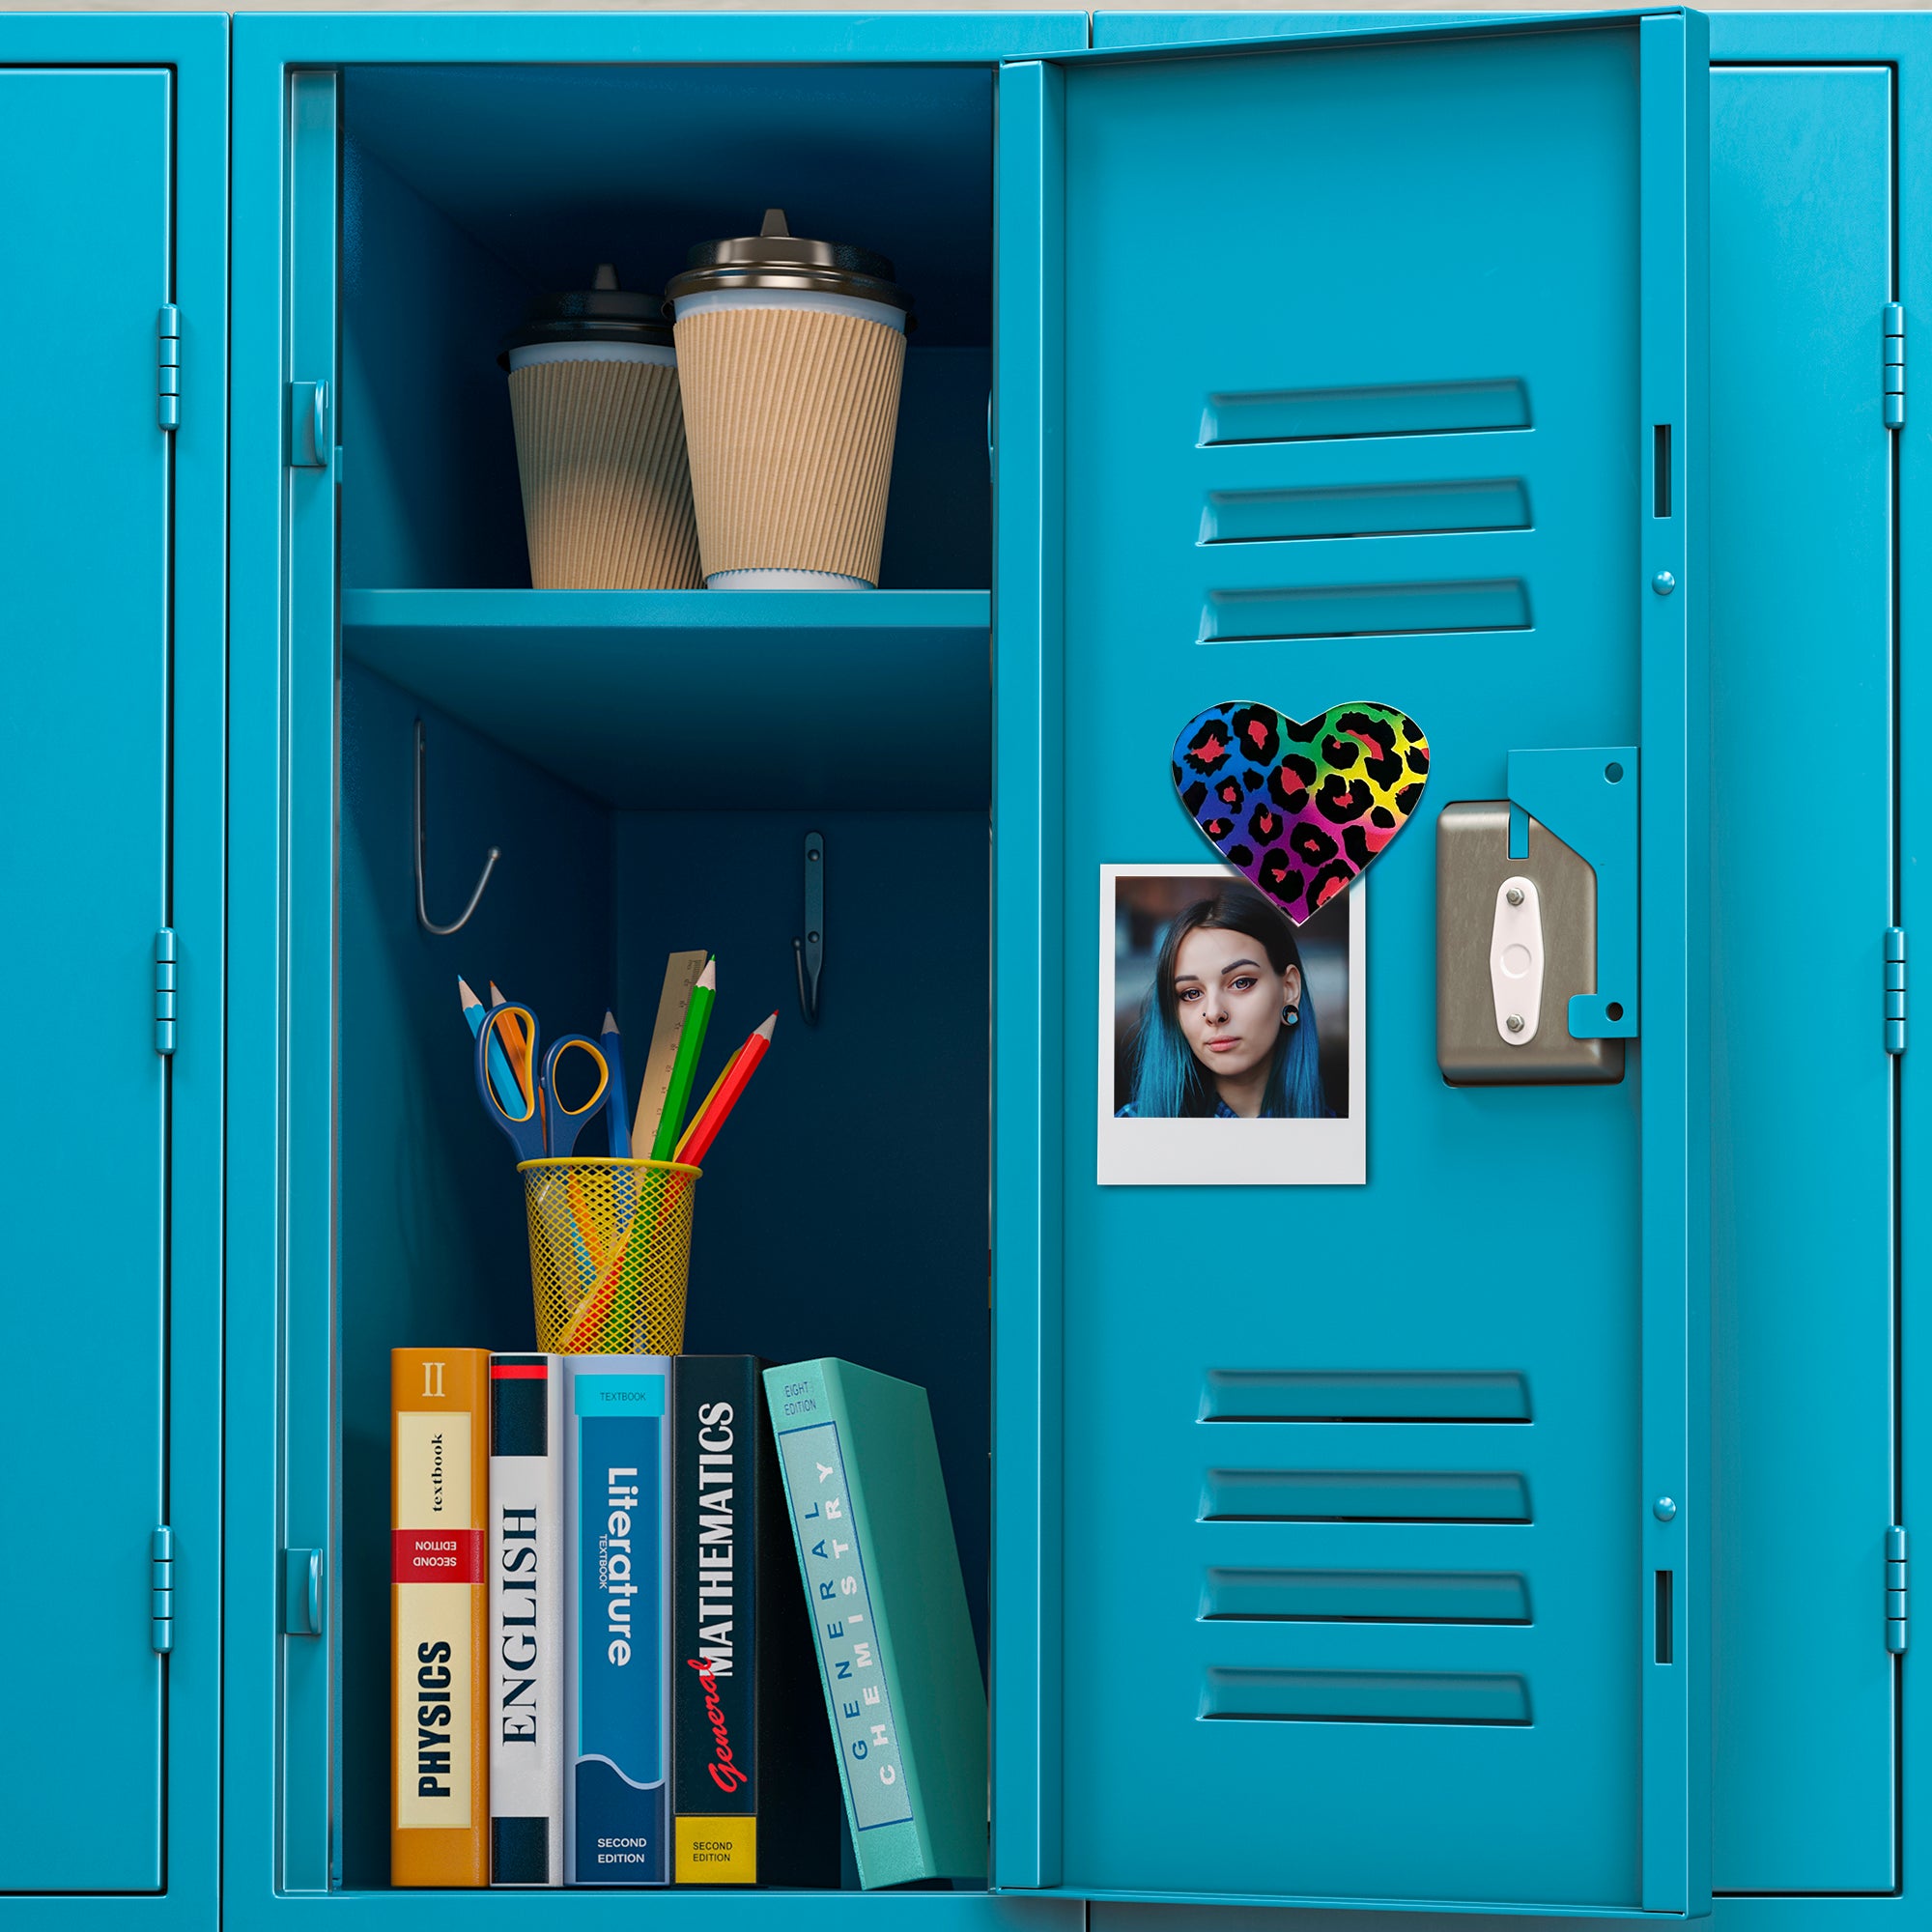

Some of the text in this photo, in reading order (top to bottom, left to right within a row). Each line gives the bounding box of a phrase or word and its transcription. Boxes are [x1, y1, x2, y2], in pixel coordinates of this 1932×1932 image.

[600, 1392, 646, 1402] TEXTBOOK
[783, 1380, 809, 1398] EIGHT
[783, 1398, 817, 1416] EDITION
[431, 1434, 442, 1512] textbook
[414, 1541, 457, 1551] EDITION
[412, 1556, 457, 1567] SECOND
[599, 1534, 608, 1589] TEXTBOOK
[608, 1468, 639, 1666] Literature
[687, 1402, 748, 1793] General MATHEMATICS
[502, 1504, 537, 1747] ENGLISH
[805, 1502, 868, 1760] GENERAL
[816, 1462, 895, 1785] CHEMISTRY
[417, 1641, 451, 1797] PHYSICS
[597, 1837, 647, 1848] SECOND
[693, 1841, 733, 1851] SECOND
[597, 1853, 645, 1863] EDITION
[693, 1853, 731, 1862] EDITION
